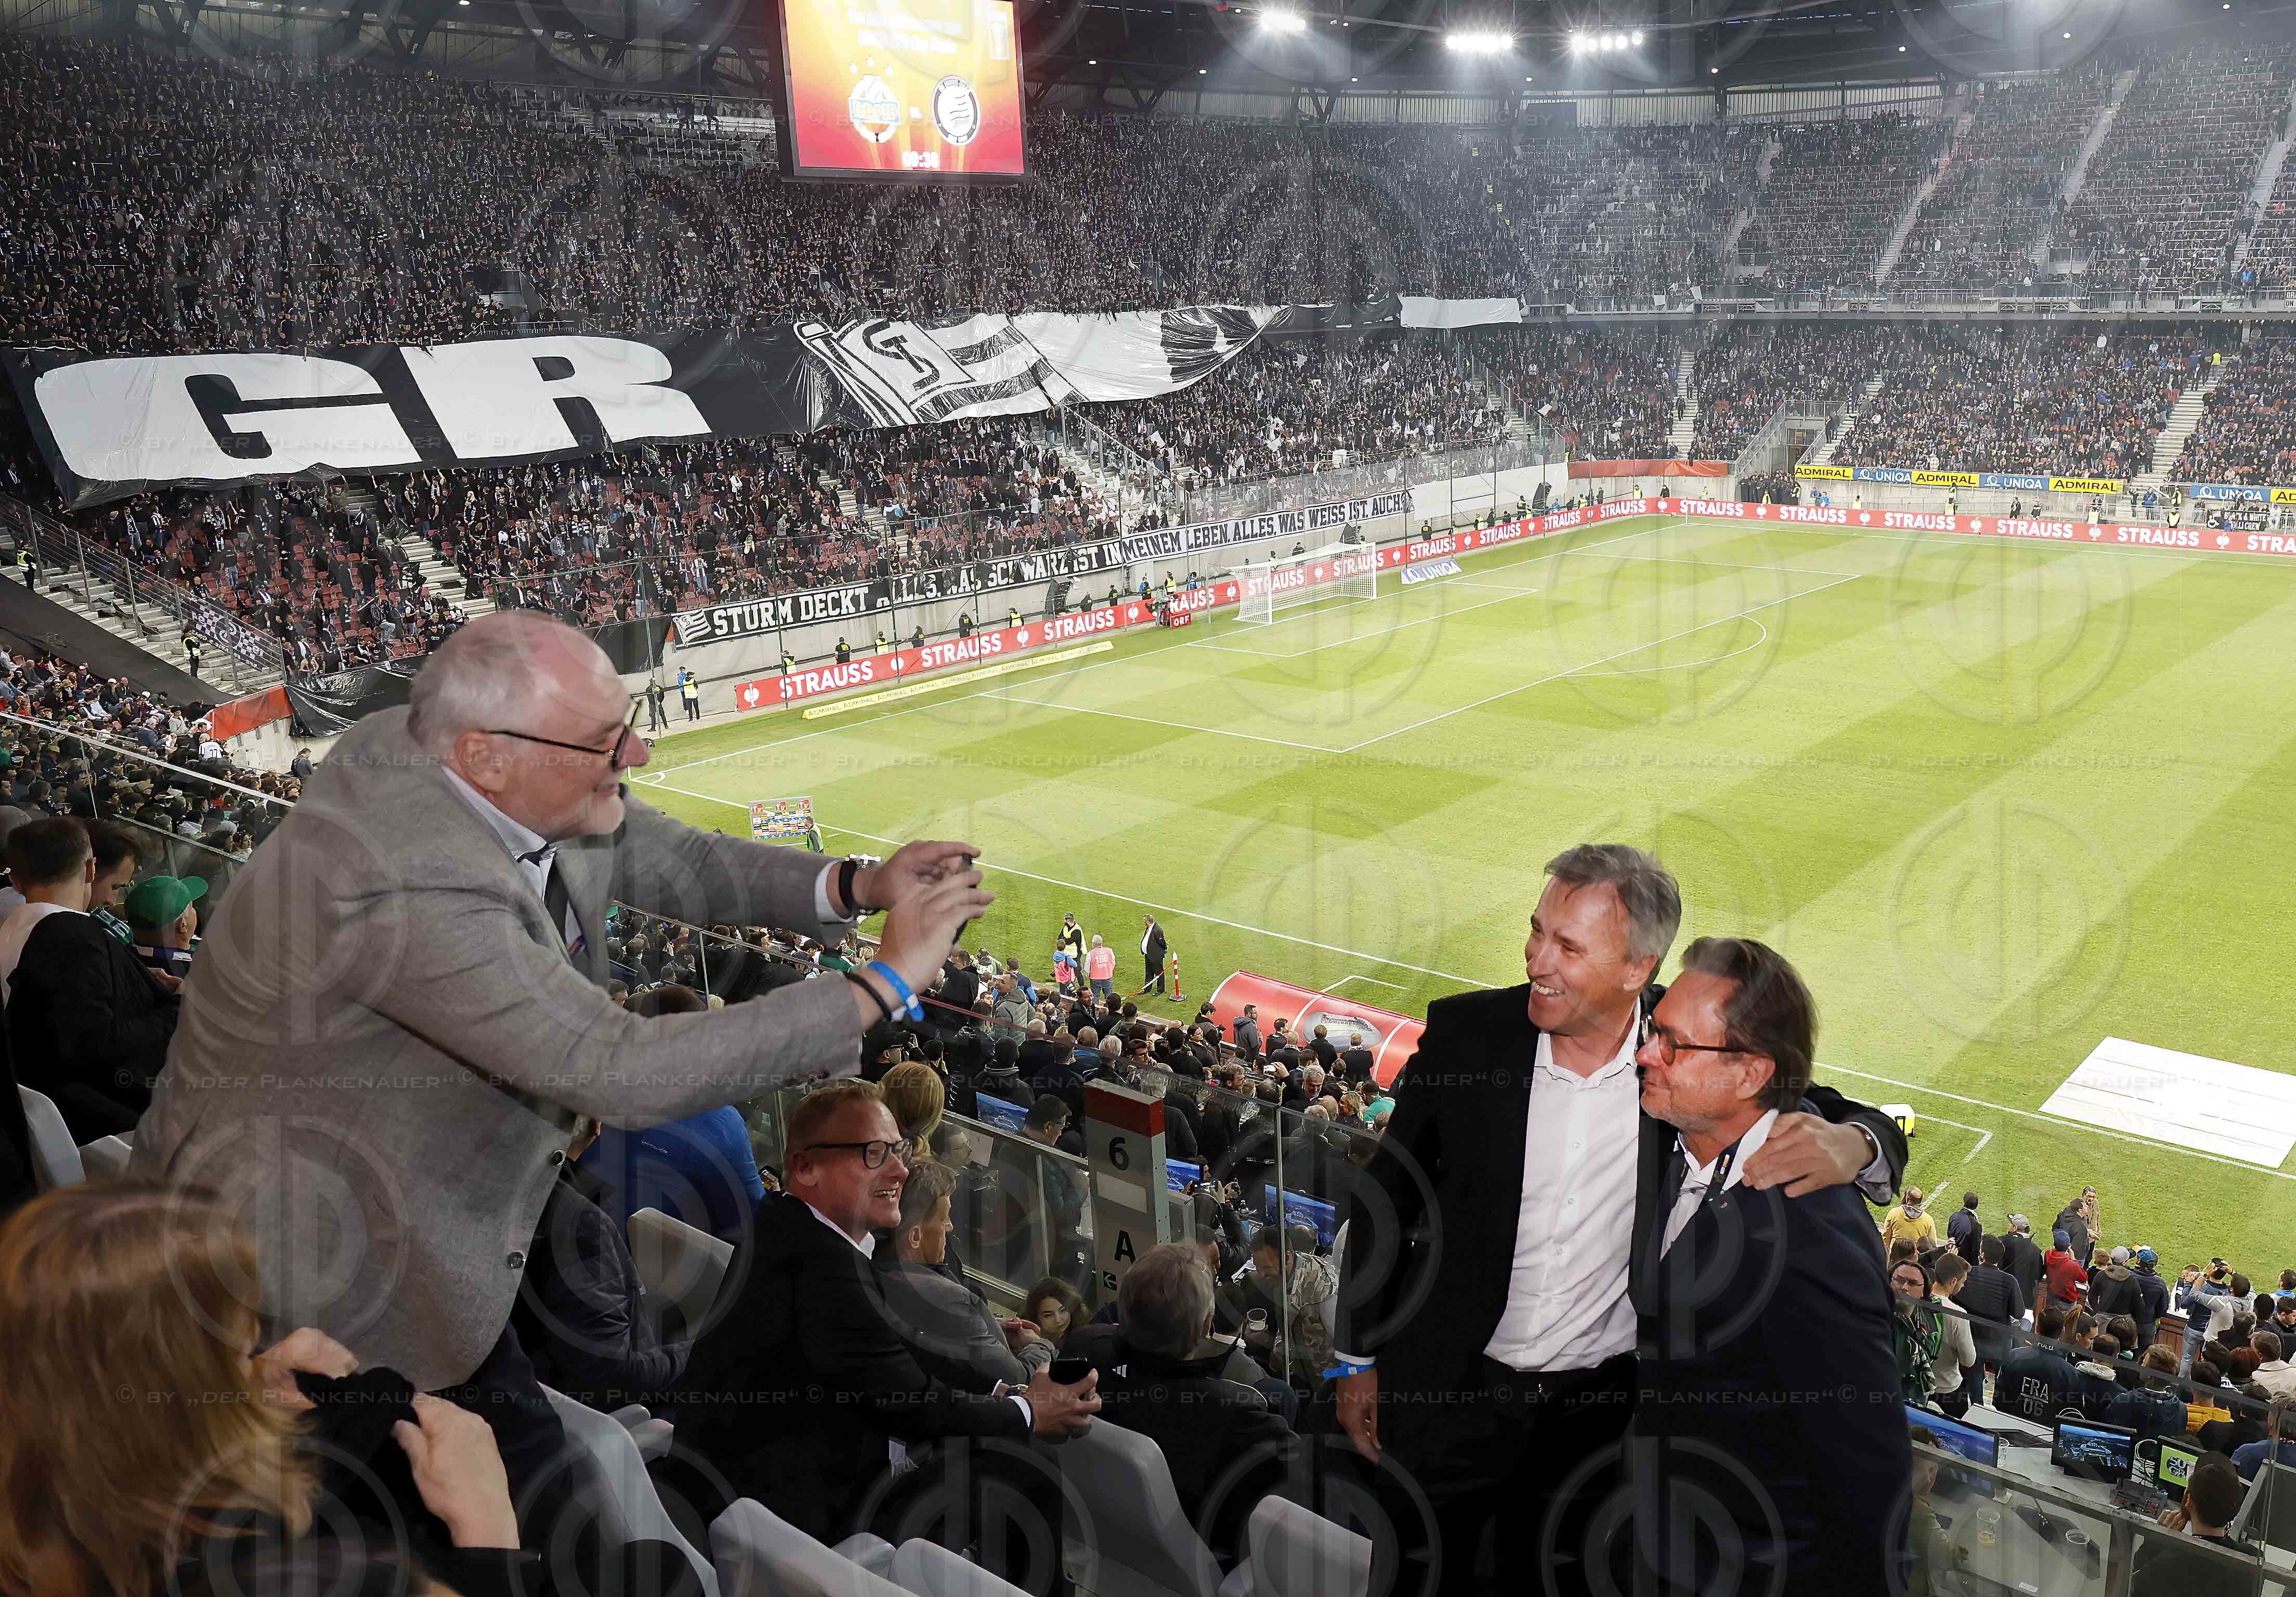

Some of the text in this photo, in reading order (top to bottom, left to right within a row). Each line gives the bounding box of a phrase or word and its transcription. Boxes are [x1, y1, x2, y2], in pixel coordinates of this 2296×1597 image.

[34, 335, 713, 481] GR
[1795, 467, 1850, 478] ADMIRAL
[1875, 471, 1912, 483] UNIQA
[1915, 472, 1976, 486] ADMIRAL
[2003, 476, 2043, 490] UNIQA
[2053, 479, 2117, 492] ADMIRAL
[2219, 488, 2263, 501] UNQA
[1600, 500, 1646, 519] STRAUSS
[1679, 499, 1744, 517] STRAUSS
[1780, 506, 1847, 523] STRAUSS
[1543, 510, 1581, 531] STRAUSS
[1884, 512, 1956, 530] STRAUSS
[1997, 519, 2073, 538] STRAUSS
[1480, 522, 1521, 545] STRAUSS
[2117, 526, 2200, 546] STRAUSS
[1410, 536, 1456, 560] STRAUSS
[712, 598, 792, 636] STURM
[800, 586, 869, 620] DECKT
[1103, 542, 1122, 566] IN
[1121, 531, 1181, 561] MEINEM
[1233, 517, 1276, 541] ALLES,
[1279, 512, 1304, 532] WAS
[1309, 504, 1346, 528] WEISS
[1421, 561, 1462, 580] UNIQA
[1043, 609, 1115, 641] STRAUSS
[1173, 615, 1189, 626] ORF
[921, 633, 1002, 667] STRAUSS
[779, 661, 873, 698] STRAUSS
[1108, 1136, 1129, 1171] 6
[1114, 1230, 1136, 1264] A
[2021, 1377, 2048, 1399] FRA
[2024, 1398, 2043, 1416] 06
